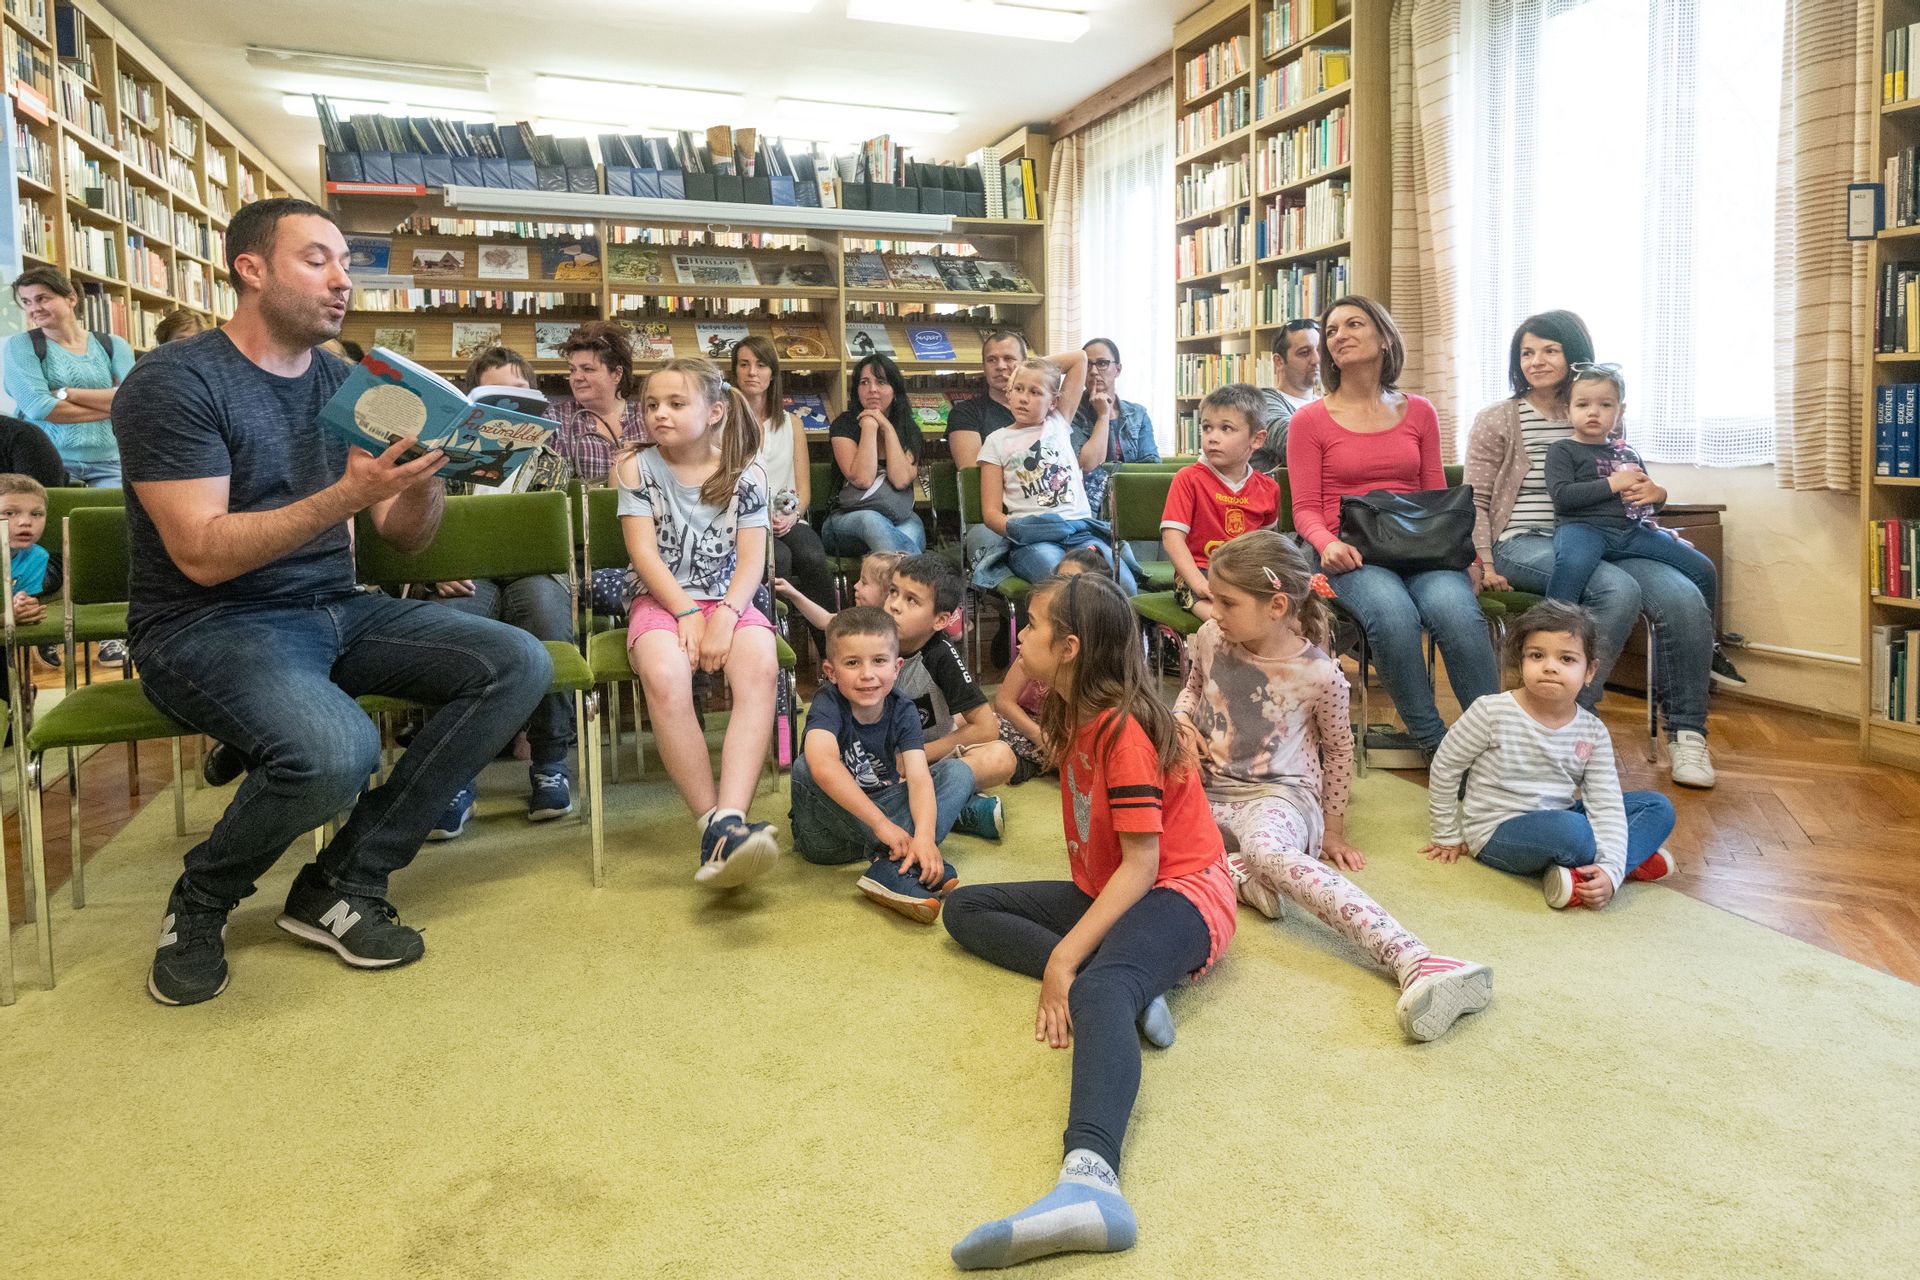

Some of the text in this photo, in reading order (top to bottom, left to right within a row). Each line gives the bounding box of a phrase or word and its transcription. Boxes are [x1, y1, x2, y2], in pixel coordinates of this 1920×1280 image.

[1897, 402, 1905, 424] ERDÉLY
[1215, 492, 1249, 504] Reebok
[942, 639, 972, 684] 1996
[319, 899, 361, 939] N
